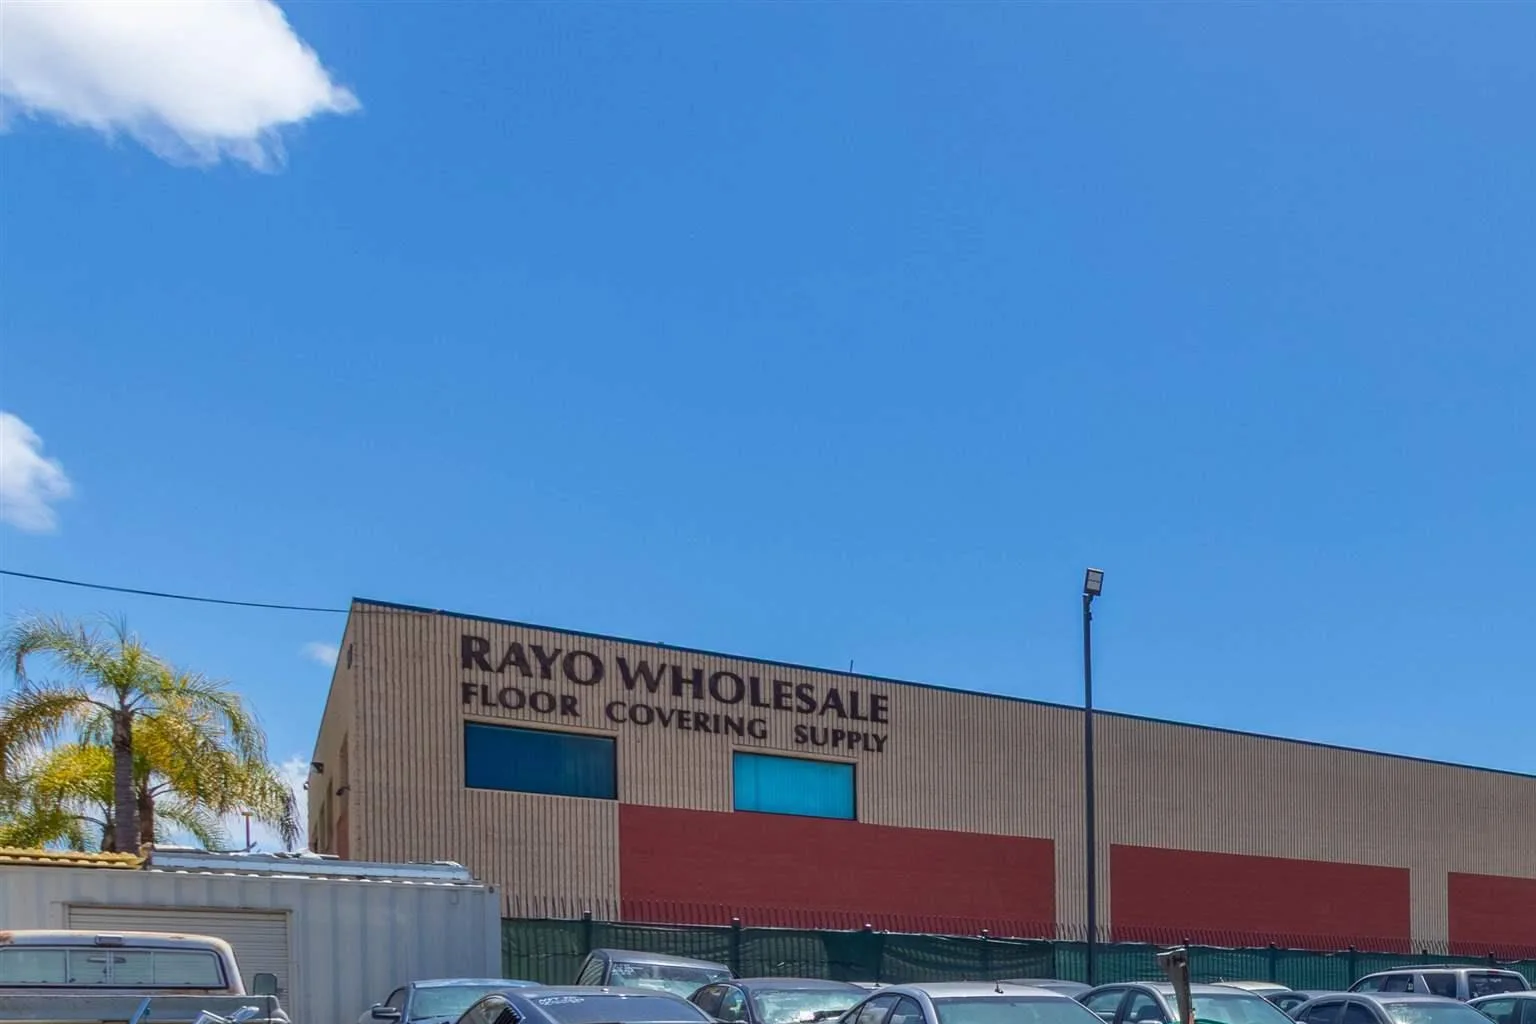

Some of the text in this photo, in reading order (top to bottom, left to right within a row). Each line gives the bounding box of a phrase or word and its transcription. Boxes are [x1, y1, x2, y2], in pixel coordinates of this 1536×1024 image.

[462, 635, 888, 724] RAYO WHOLESALE
[462, 682, 887, 752] FLOOR COVERING SUPPLY
